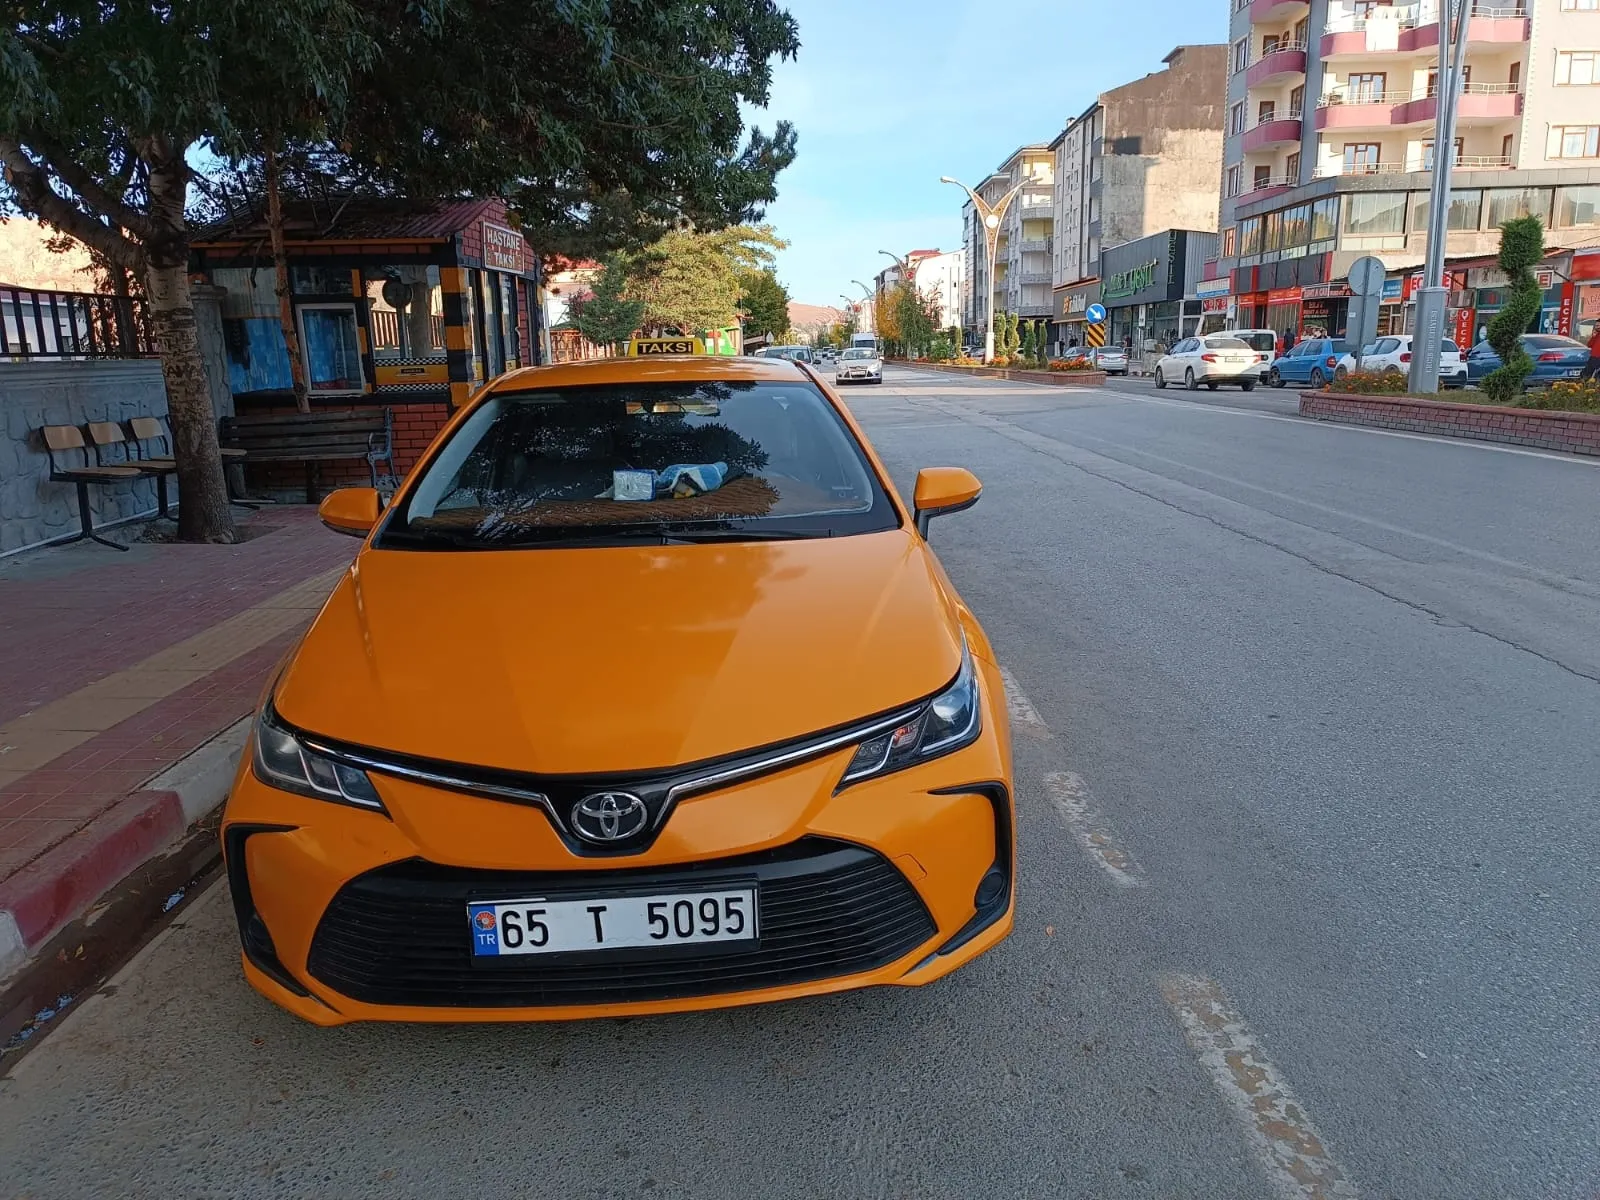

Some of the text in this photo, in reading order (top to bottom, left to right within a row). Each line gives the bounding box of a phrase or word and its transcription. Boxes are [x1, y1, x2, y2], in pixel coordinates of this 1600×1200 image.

[487, 228, 520, 250] HASTANE
[477, 897, 744, 948] TR 65 T 5095
